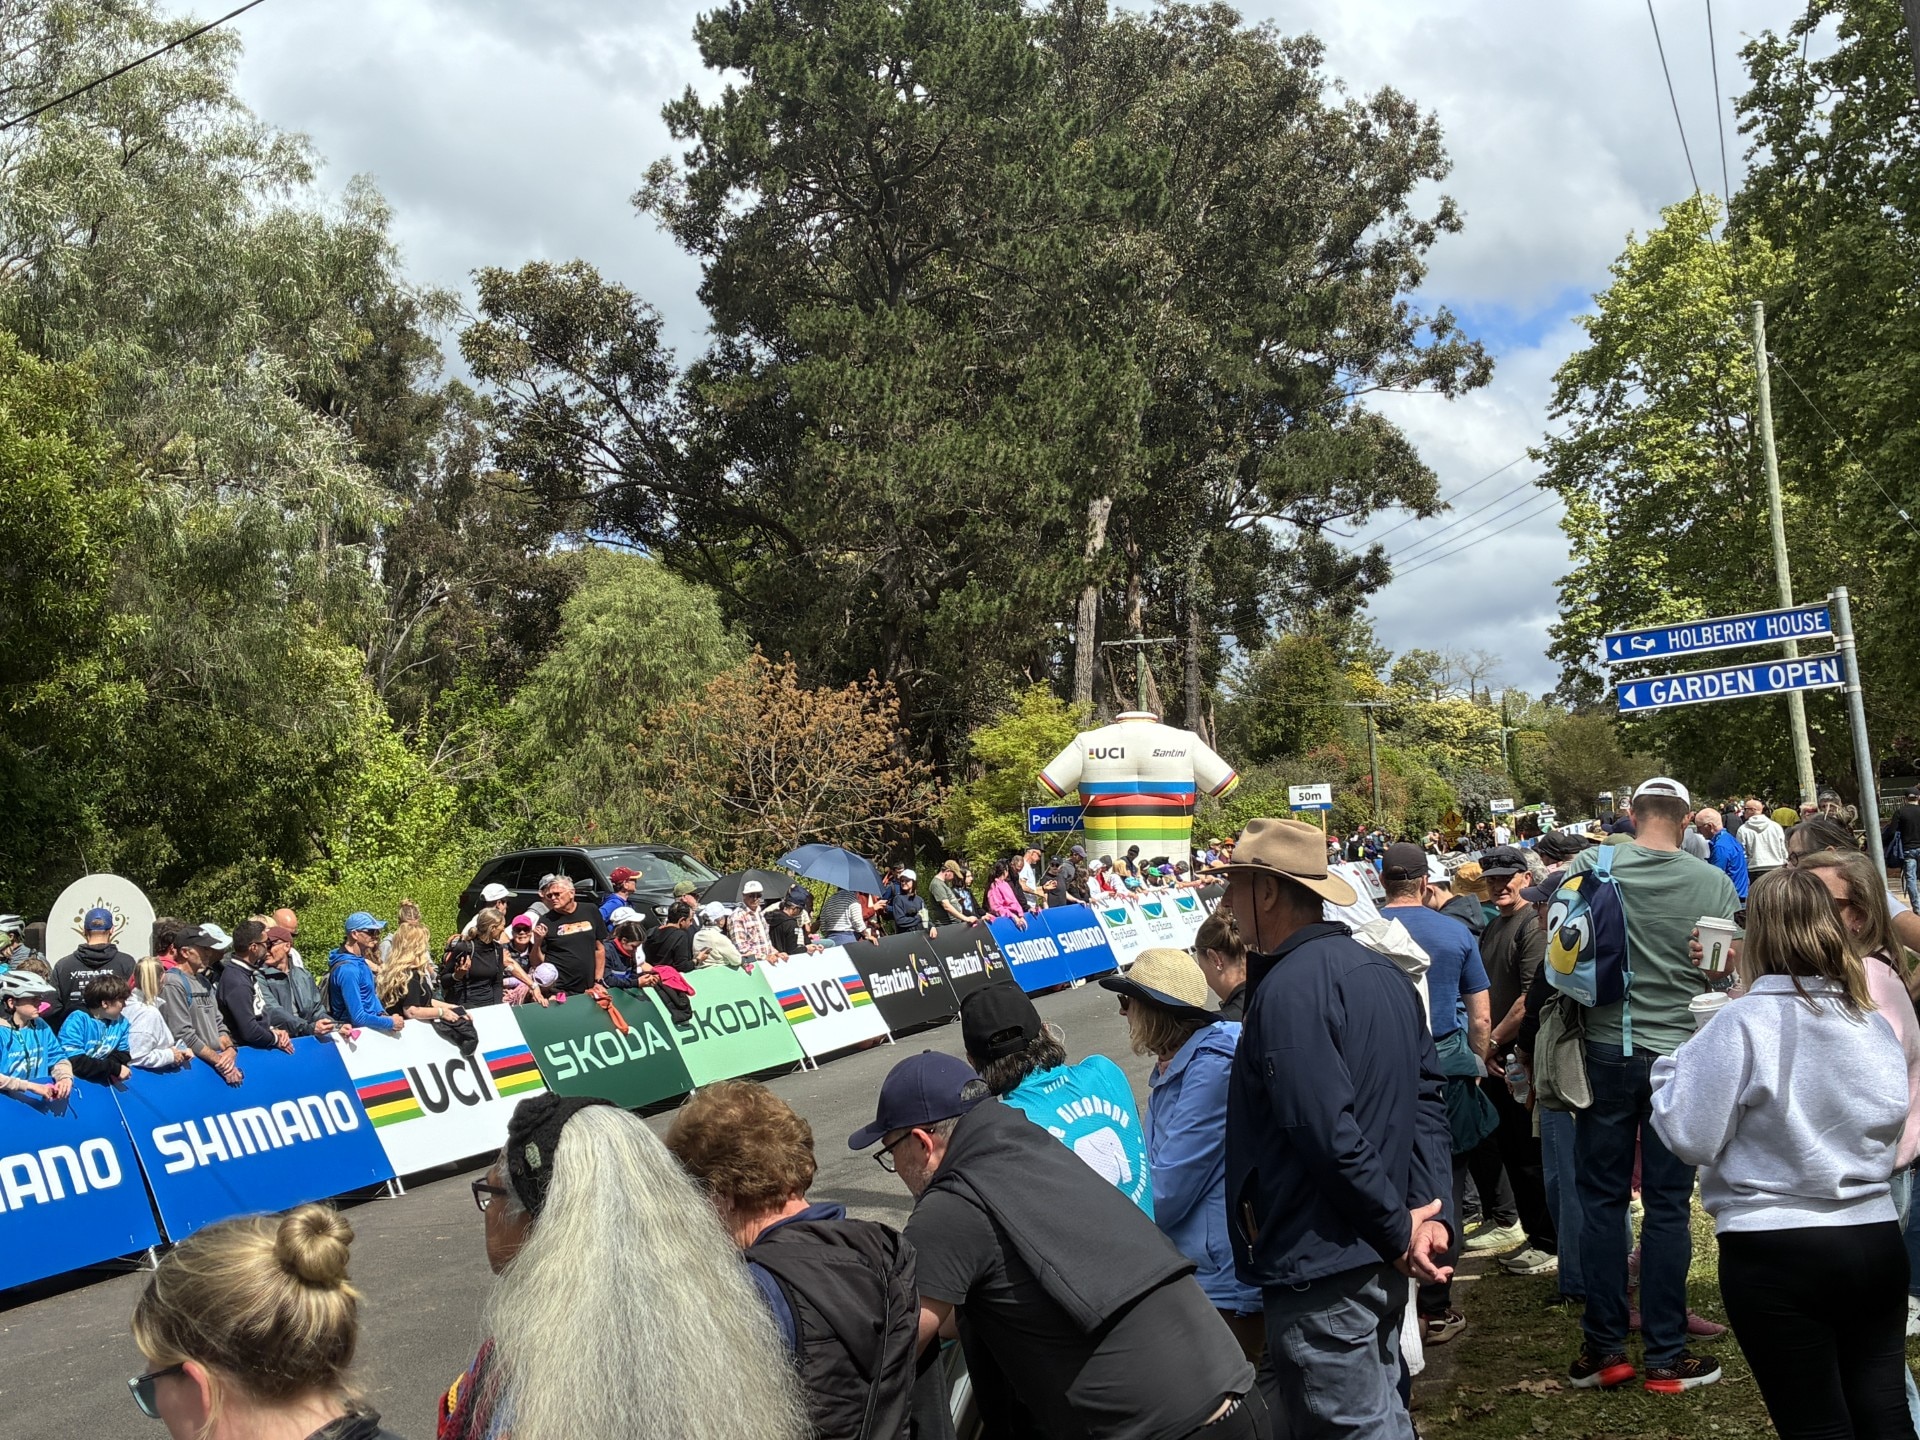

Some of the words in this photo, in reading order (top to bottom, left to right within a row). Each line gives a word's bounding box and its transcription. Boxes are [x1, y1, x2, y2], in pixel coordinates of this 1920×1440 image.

[1668, 620, 1757, 650] HOLBERRY
[1766, 610, 1826, 638] HOUSE
[1649, 669, 1756, 704] GARDEN
[1767, 658, 1840, 690] OPEN
[1095, 747, 1125, 760] UCI
[1152, 748, 1187, 758] Santini
[1298, 792, 1322, 801] 50m
[1032, 813, 1075, 826] Parking
[1004, 936, 1059, 966] SHIMANO
[1057, 925, 1106, 954] SHIMANO
[945, 950, 983, 979] Santini
[802, 978, 851, 1017] UCI
[869, 965, 915, 999] Santini
[407, 1053, 494, 1114] UCI
[151, 1089, 360, 1175] SHIMANO
[0, 1137, 122, 1213] ANO
